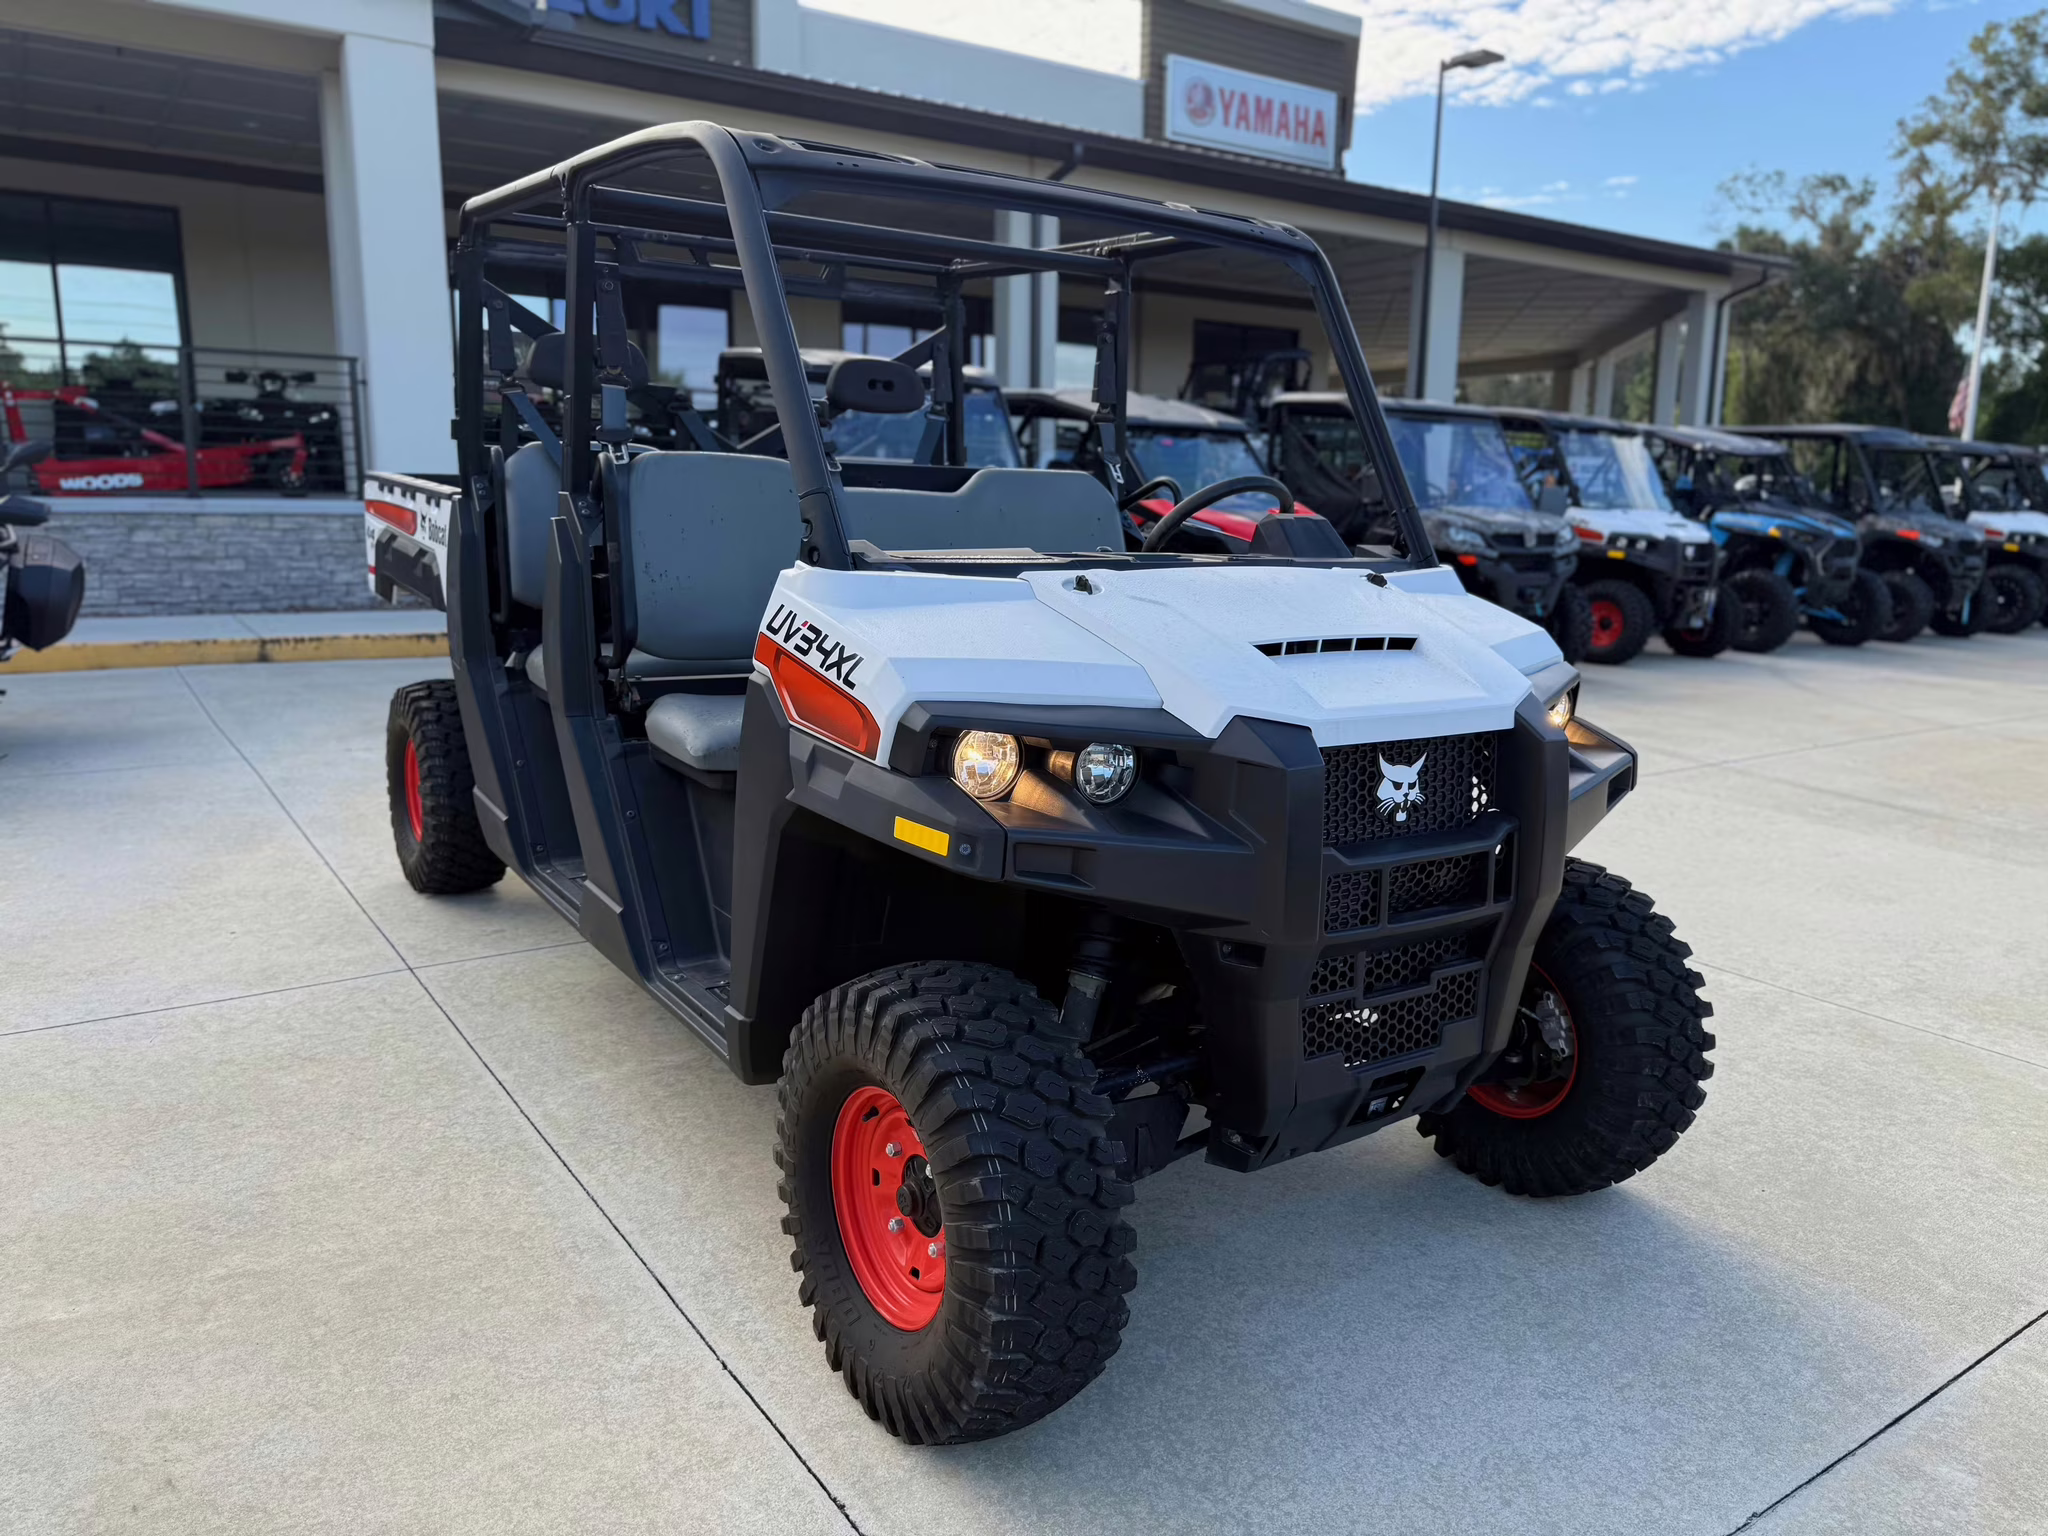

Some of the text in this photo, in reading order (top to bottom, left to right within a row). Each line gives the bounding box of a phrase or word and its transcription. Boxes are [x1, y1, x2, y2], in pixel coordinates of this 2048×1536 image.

[1218, 86, 1326, 148] YAMAHA
[60, 473, 143, 490] WOODS
[428, 516, 447, 547] Bobcat
[766, 604, 864, 690] UV34XL
